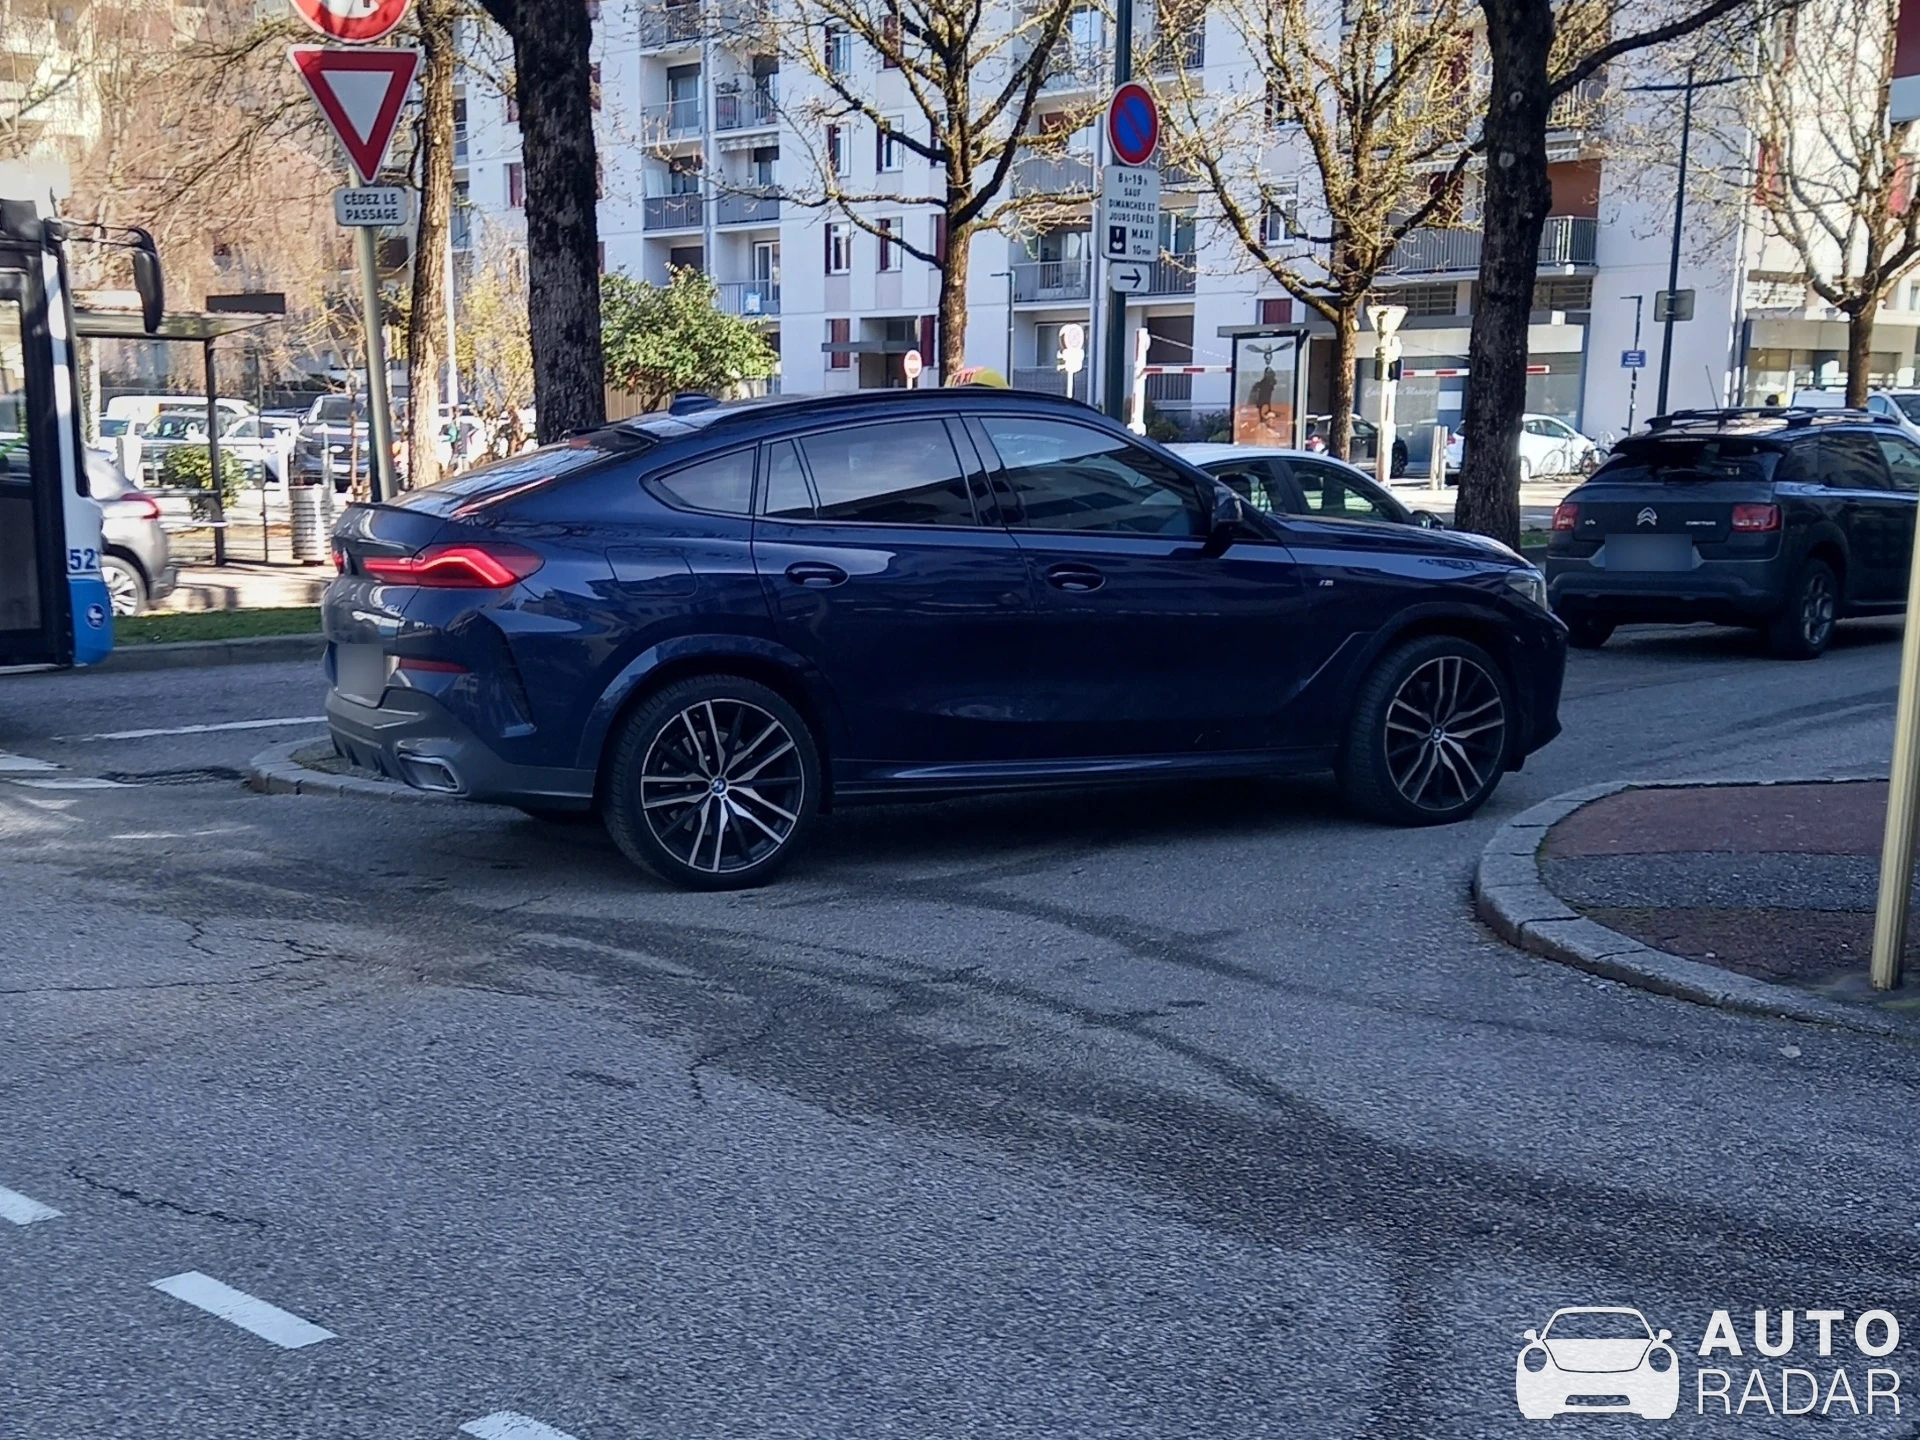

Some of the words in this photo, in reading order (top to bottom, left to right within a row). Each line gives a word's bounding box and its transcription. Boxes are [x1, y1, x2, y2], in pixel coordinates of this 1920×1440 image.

[344, 191, 380, 205] CÉDEZ
[384, 193, 398, 205] LE
[1124, 187, 1141, 197] SAUF
[1109, 198, 1146, 210] DIMANCHES
[1147, 202, 1155, 211] ET
[345, 208, 399, 220] PASSAGE
[1109, 212, 1130, 222] JOURS
[1132, 212, 1154, 224] FÉRIÉS
[1131, 228, 1153, 240] MAXI
[950, 371, 974, 387] TAXI
